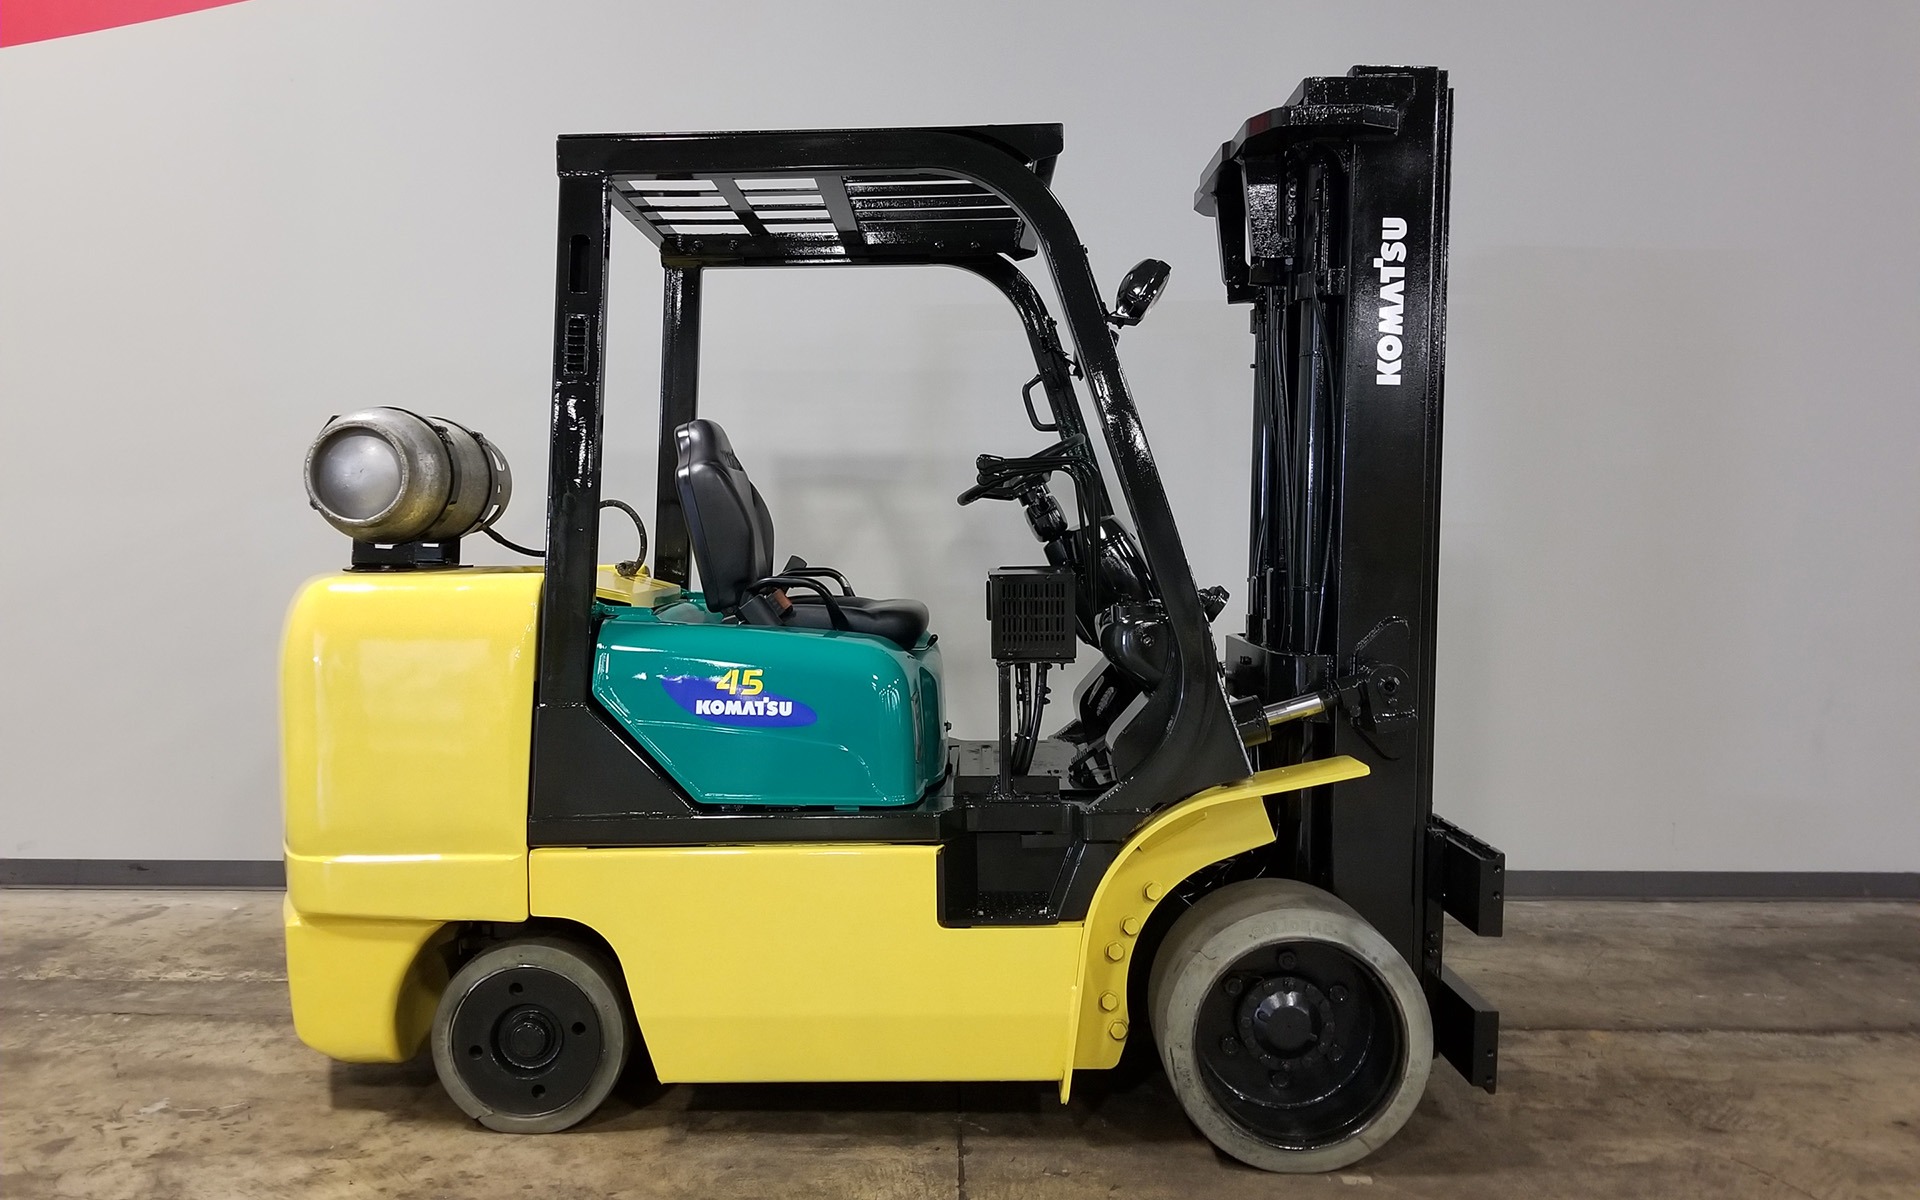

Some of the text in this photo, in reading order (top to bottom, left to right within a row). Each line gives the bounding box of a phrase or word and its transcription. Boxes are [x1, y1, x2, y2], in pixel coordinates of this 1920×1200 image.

[1373, 217, 1408, 386] KOMATSU
[716, 669, 764, 696] 45
[696, 697, 793, 717] KOMATSU
